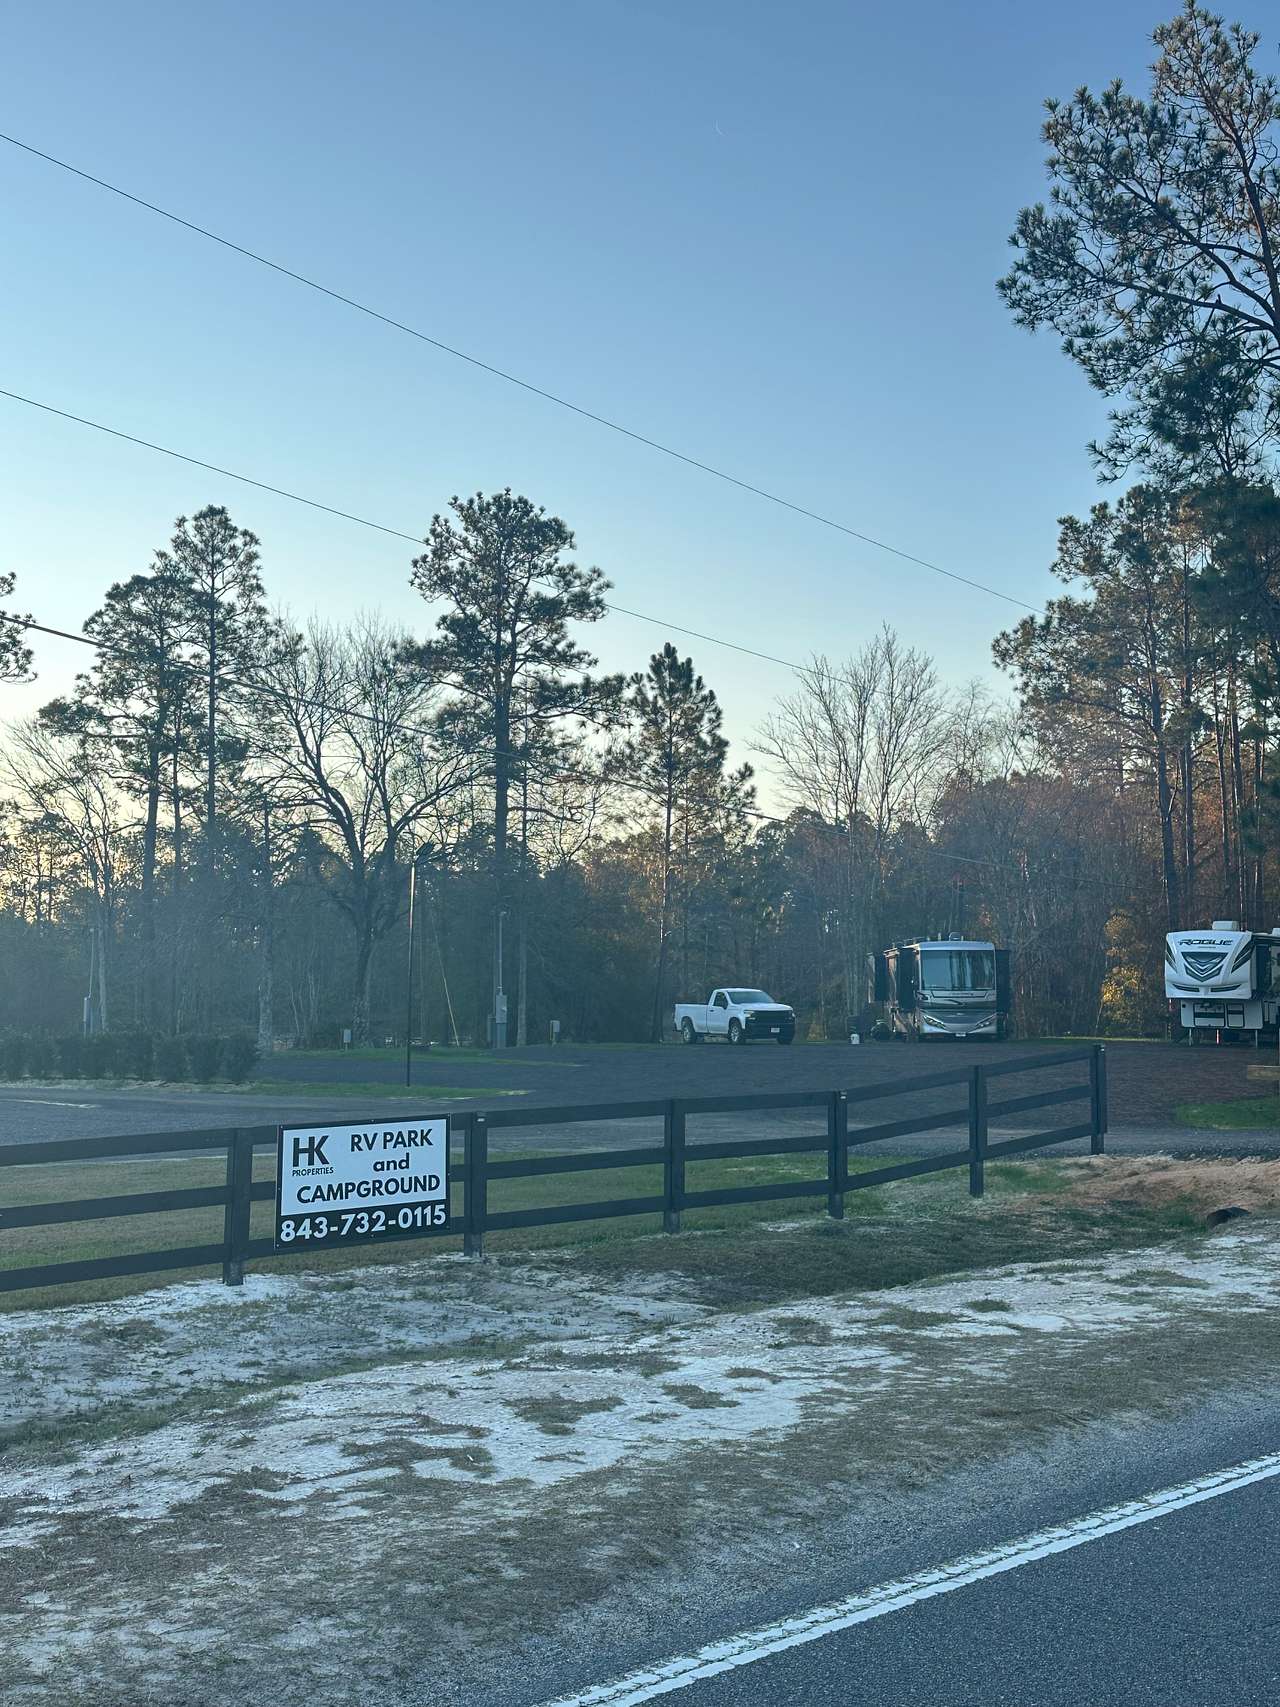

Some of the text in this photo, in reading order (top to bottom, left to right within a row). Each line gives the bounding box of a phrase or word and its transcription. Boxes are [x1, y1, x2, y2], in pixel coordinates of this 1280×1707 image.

[292, 1135, 330, 1167] HK
[350, 1128, 433, 1152] RV PARK
[291, 1166, 334, 1177] PROPERTIES
[373, 1152, 410, 1172] and
[296, 1174, 440, 1204] CAMPGROUND
[280, 1204, 447, 1242] 843-732-0115
